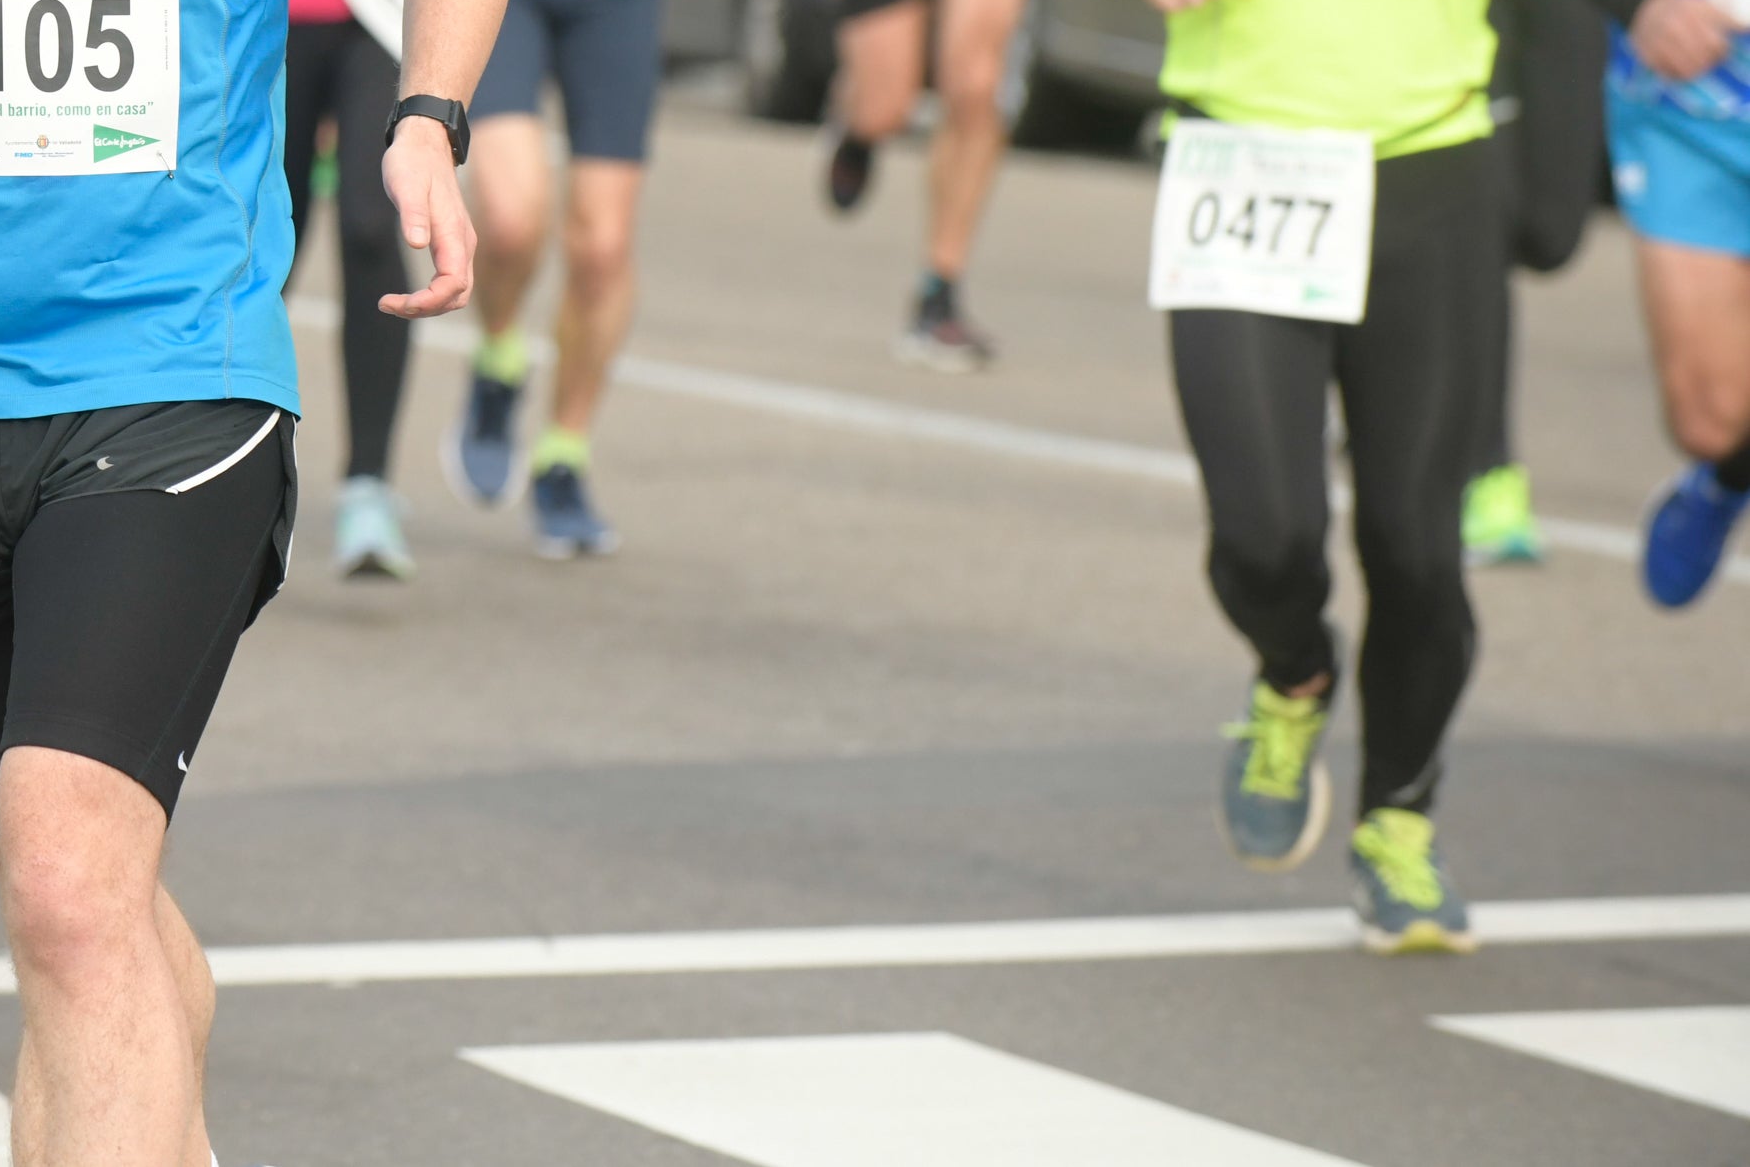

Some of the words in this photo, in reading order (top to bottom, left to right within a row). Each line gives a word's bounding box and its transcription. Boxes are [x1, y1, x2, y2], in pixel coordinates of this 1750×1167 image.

[8, 103, 51, 118] barrio,
[56, 105, 91, 116] como
[96, 105, 112, 116] en
[1187, 192, 1333, 258] 0477
